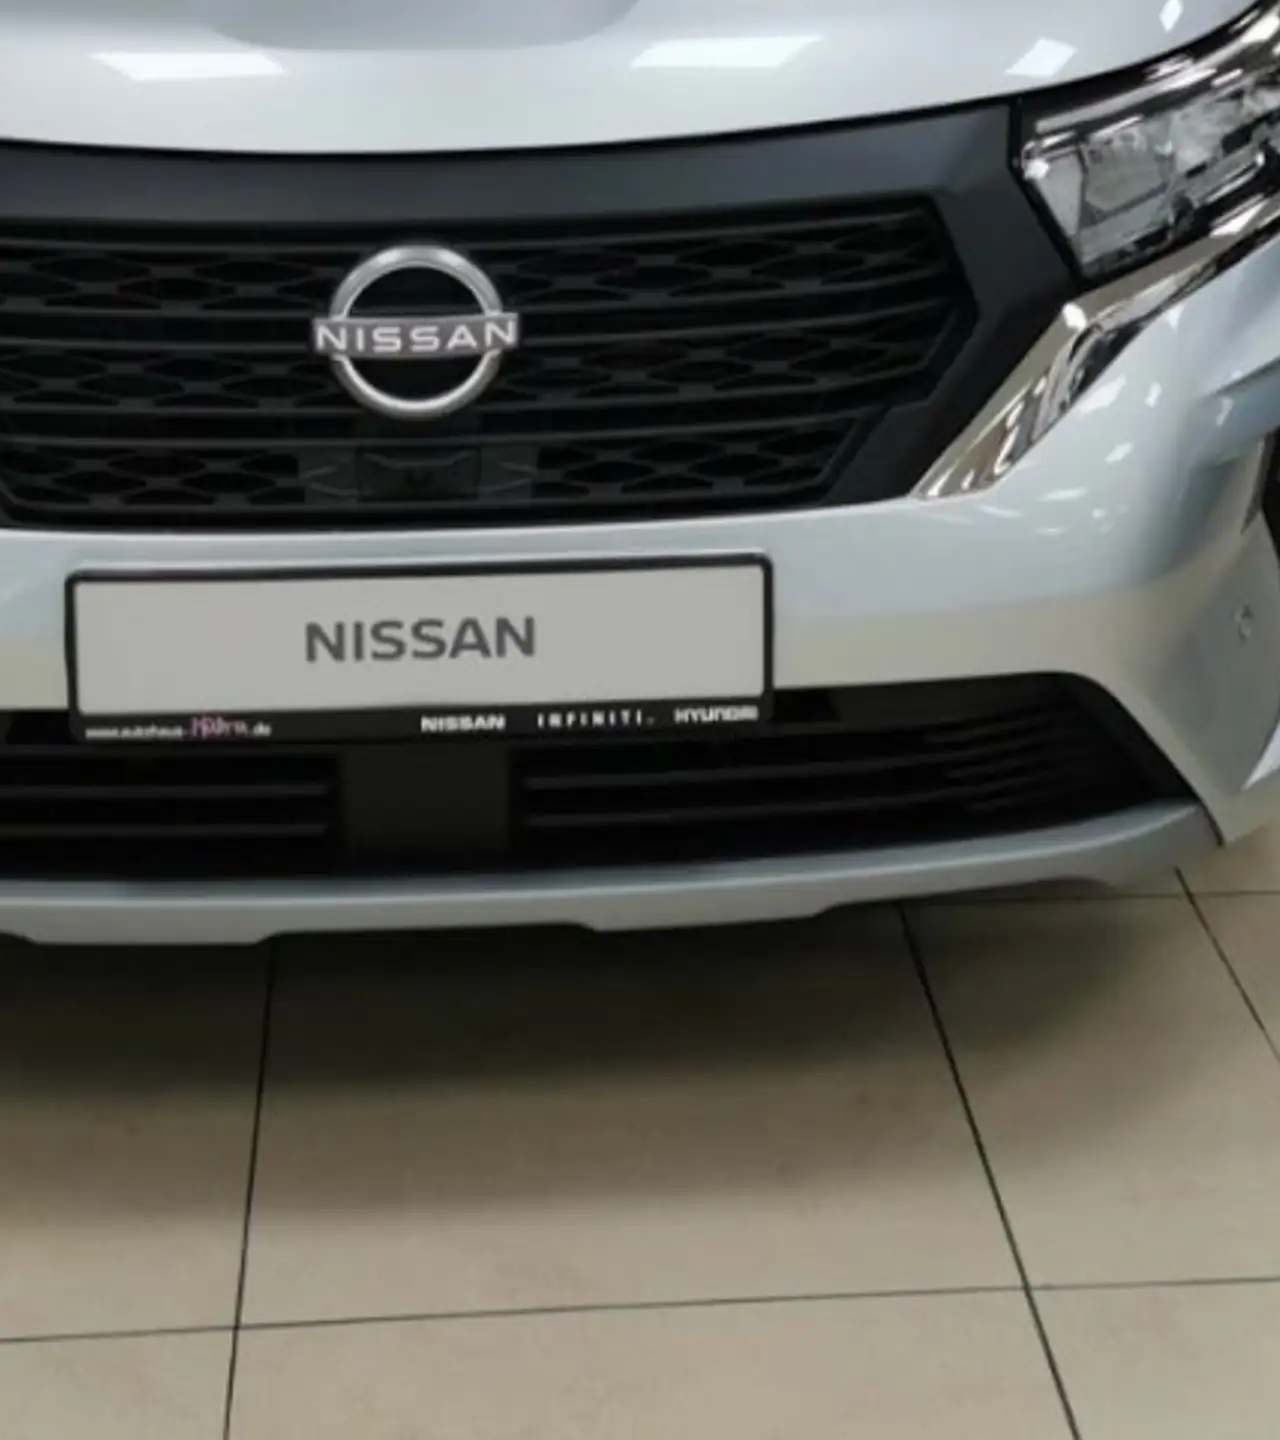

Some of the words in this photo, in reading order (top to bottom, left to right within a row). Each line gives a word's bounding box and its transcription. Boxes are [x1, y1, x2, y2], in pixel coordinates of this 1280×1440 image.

[315, 318, 518, 354] NISSAN
[305, 615, 536, 663] NISSAN
[420, 714, 507, 733] NISSAN
